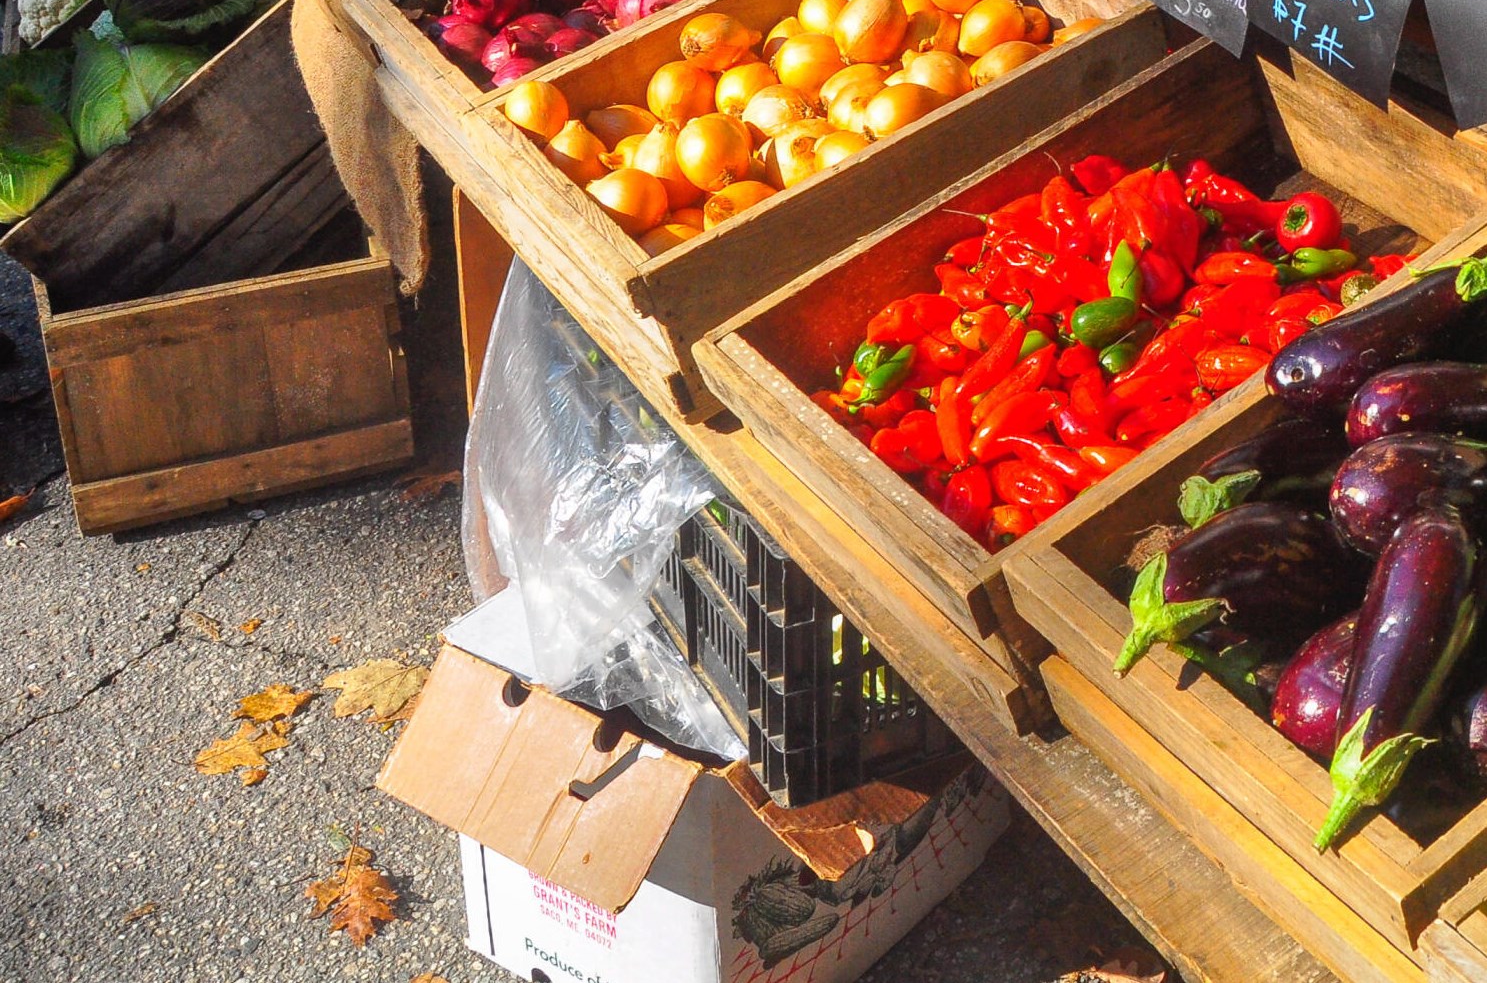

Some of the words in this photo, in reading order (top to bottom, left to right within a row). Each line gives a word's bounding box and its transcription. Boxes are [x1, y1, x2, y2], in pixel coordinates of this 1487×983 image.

[533, 885, 581, 920] GRANT'S
[585, 912, 617, 939] FARM
[525, 937, 583, 981] Produce
